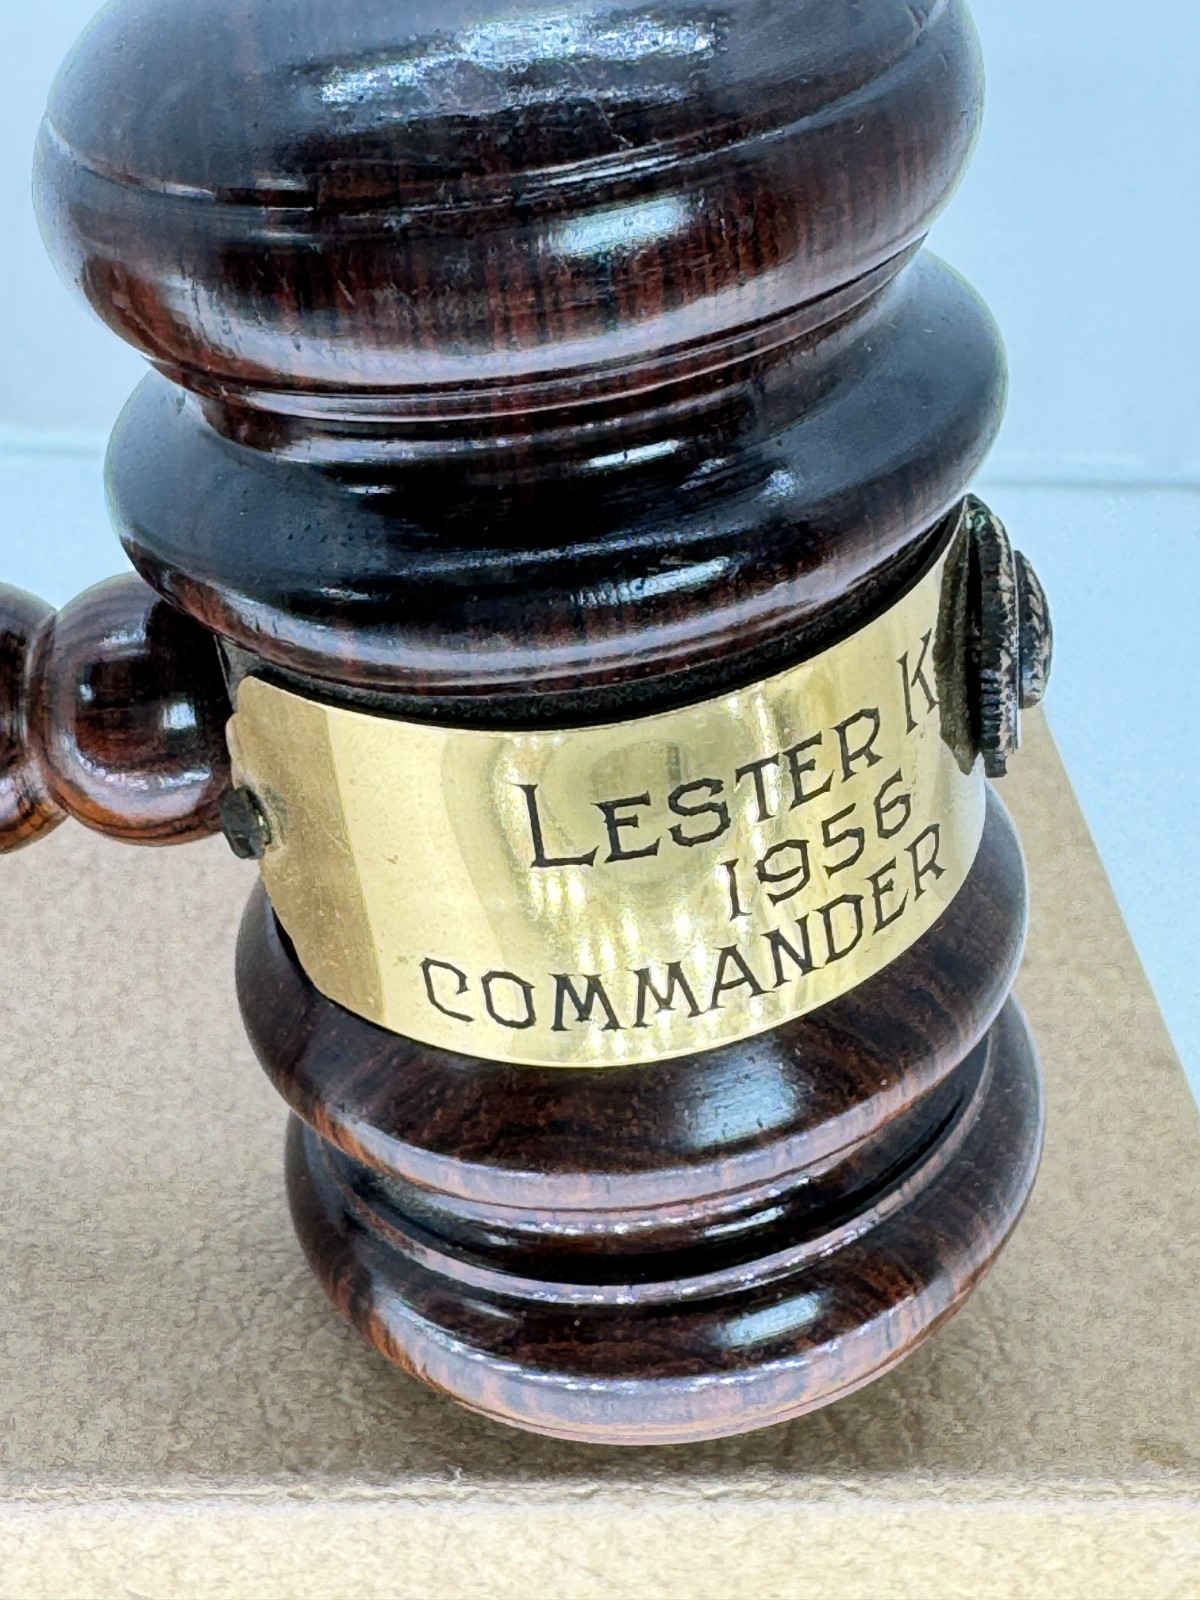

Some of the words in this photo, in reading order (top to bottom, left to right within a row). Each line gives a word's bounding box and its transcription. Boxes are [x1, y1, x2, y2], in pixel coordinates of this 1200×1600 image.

[514, 707, 883, 868] LESTER
[720, 768, 912, 921] 1956
[421, 823, 946, 1031] COMMANDER
